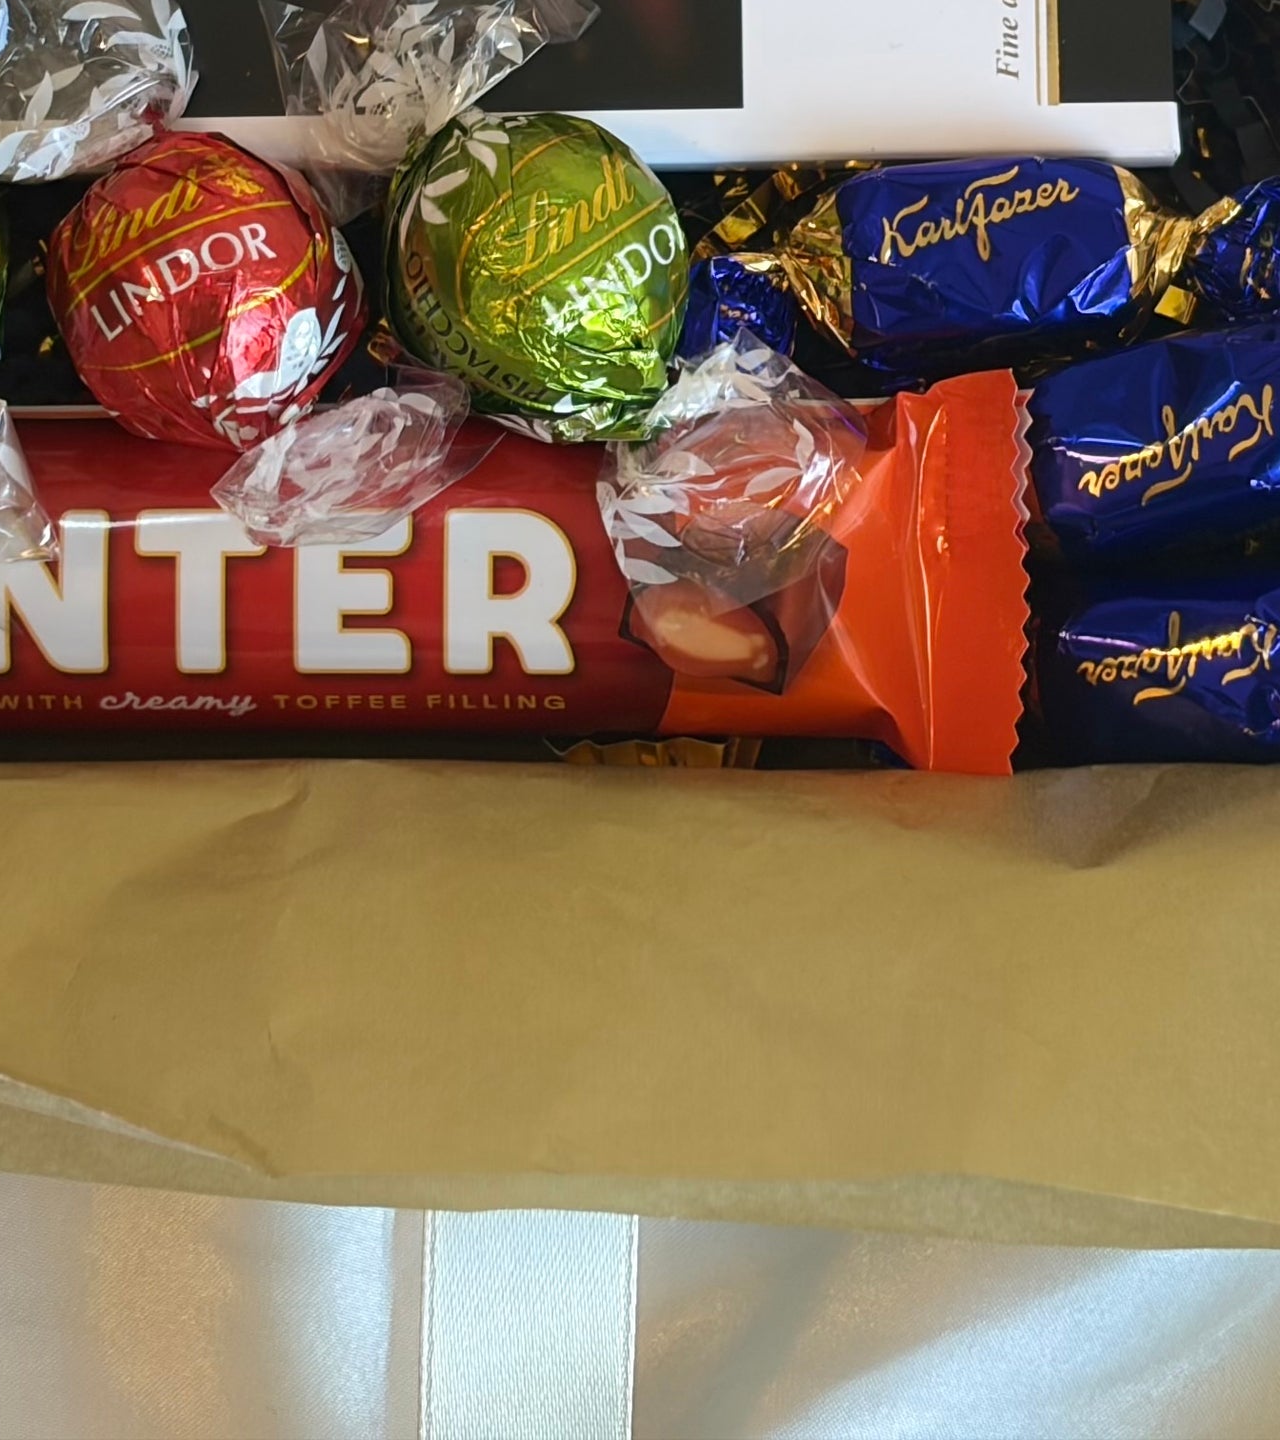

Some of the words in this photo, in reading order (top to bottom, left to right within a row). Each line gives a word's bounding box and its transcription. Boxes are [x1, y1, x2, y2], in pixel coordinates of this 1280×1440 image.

[995, 17, 1021, 80] Fine
[70, 166, 204, 282] Lindt
[497, 153, 636, 286] Lindt
[90, 222, 278, 342] LINDOR
[98, 687, 257, 718] creamy
[273, 694, 409, 711] TOFFEE
[425, 694, 568, 711] FILLING
